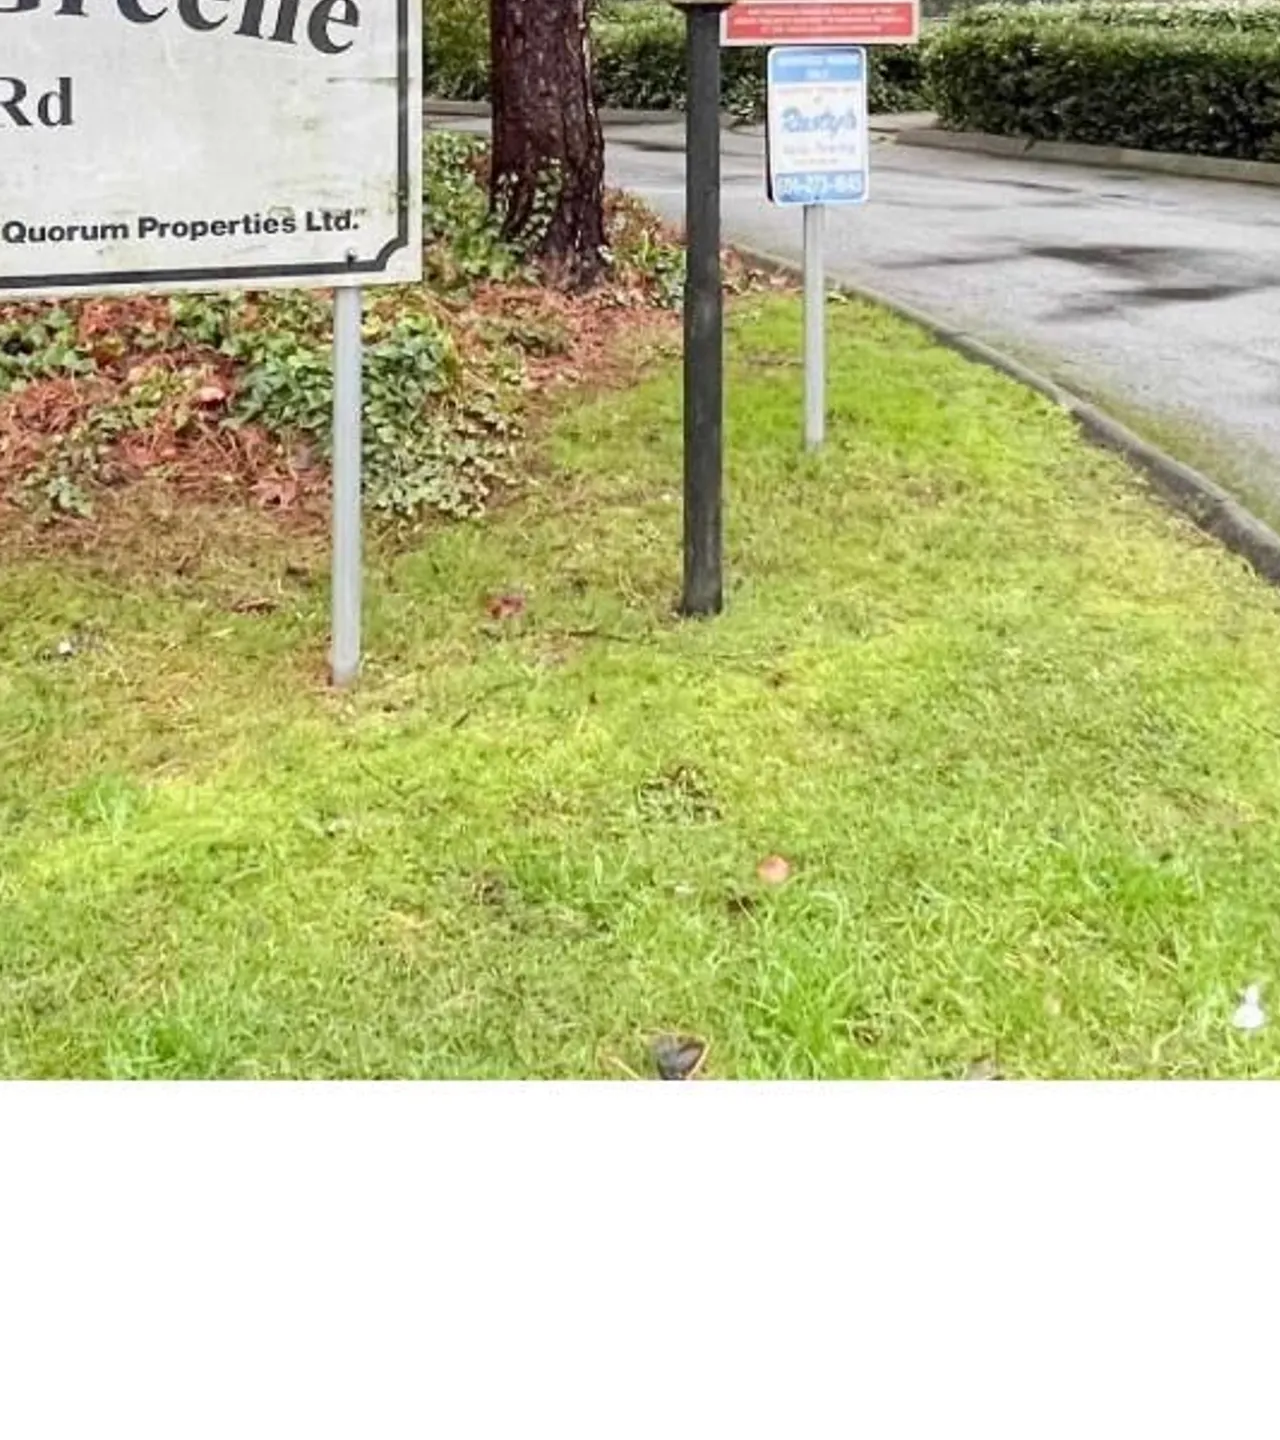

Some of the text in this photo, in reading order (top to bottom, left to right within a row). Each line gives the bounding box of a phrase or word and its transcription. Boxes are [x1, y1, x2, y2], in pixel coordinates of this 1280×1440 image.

[1, 220, 130, 246] Quorum
[138, 212, 297, 242] Properties
[305, 208, 360, 233] Ltd.
